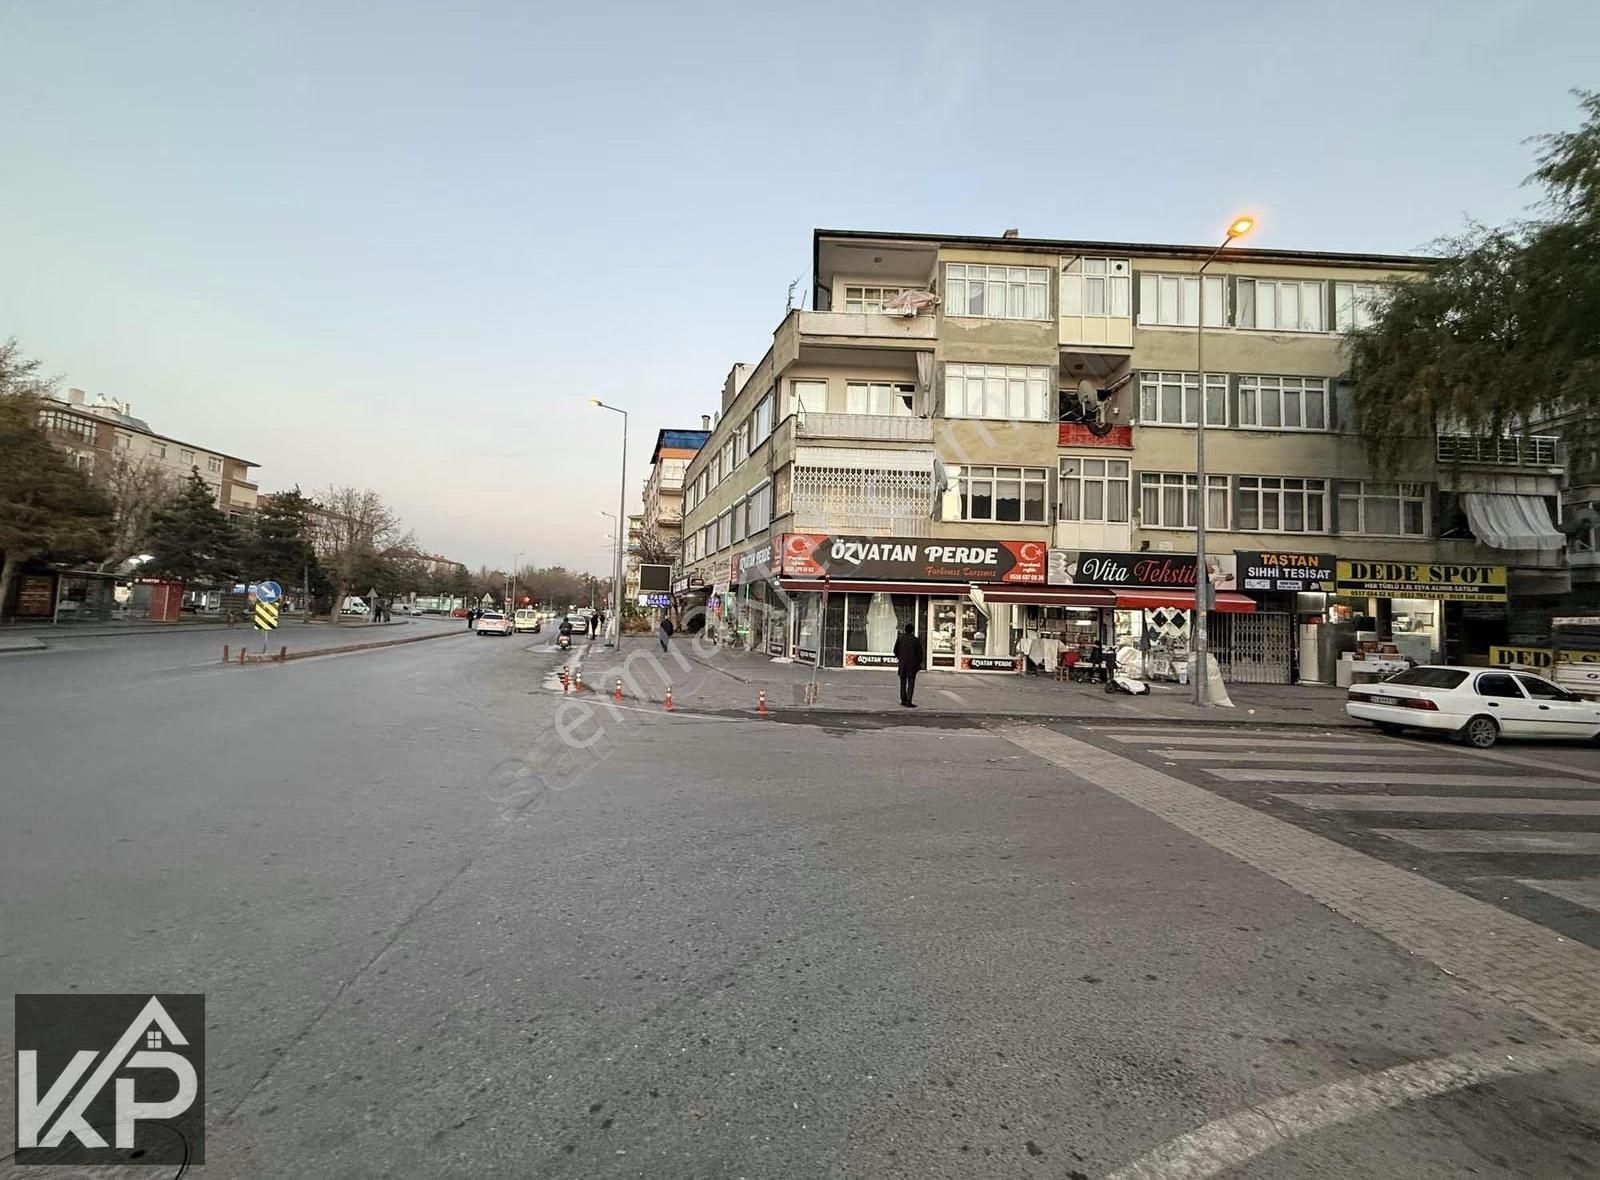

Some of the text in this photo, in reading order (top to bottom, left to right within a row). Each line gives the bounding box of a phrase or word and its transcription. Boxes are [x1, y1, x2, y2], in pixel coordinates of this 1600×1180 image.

[831, 539, 917, 565] ÖZVATAN
[924, 546, 999, 565] PERDE
[1261, 554, 1319, 567] TAŞTAN
[1082, 558, 1198, 584] Vita Tekstil
[1248, 565, 1331, 580] SIHHİ TESİSAT
[1350, 563, 1493, 584] DEDE SPOT
